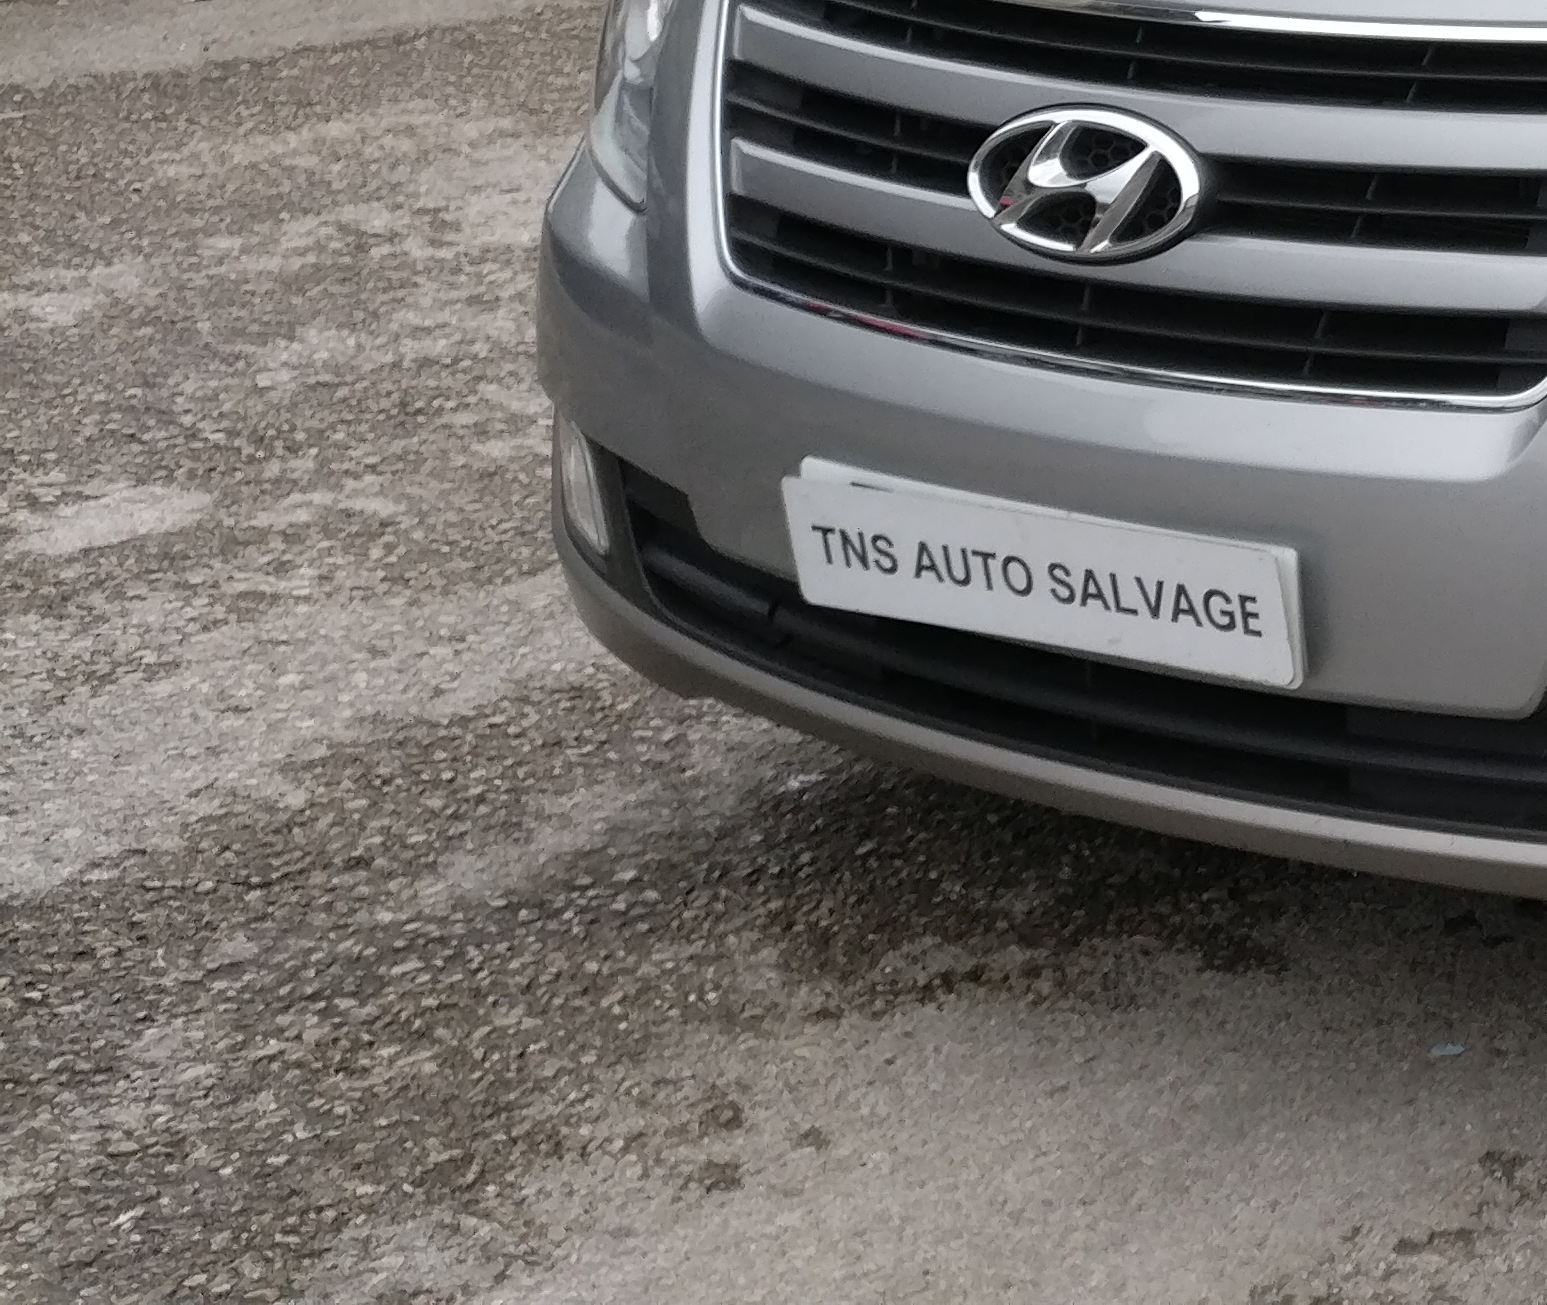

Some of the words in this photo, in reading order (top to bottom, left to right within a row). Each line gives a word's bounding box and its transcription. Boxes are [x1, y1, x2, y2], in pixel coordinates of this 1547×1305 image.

[811, 524, 899, 576] TNS
[914, 540, 1034, 597] AUTO
[1047, 561, 1264, 638] SALVAGE
